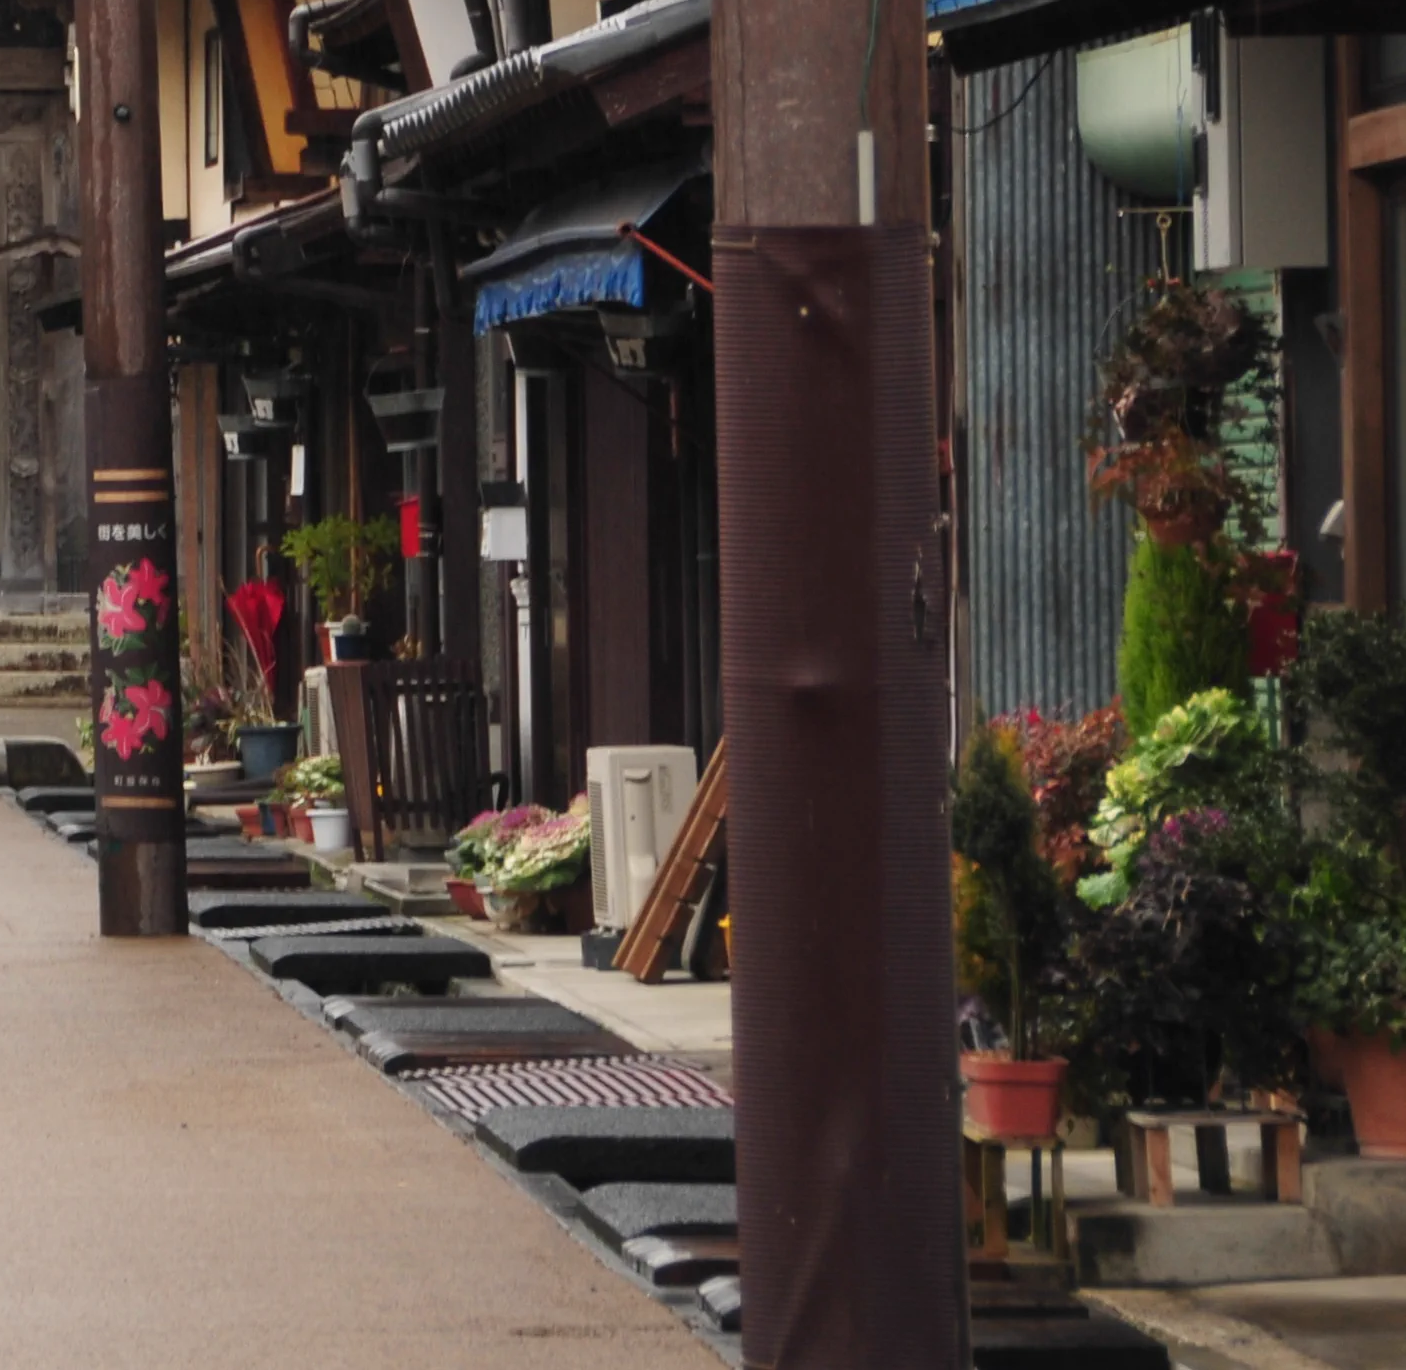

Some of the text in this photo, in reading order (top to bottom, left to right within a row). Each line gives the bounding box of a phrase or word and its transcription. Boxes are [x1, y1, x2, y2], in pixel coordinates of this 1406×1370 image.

[98, 522, 167, 542] 街を美しく
